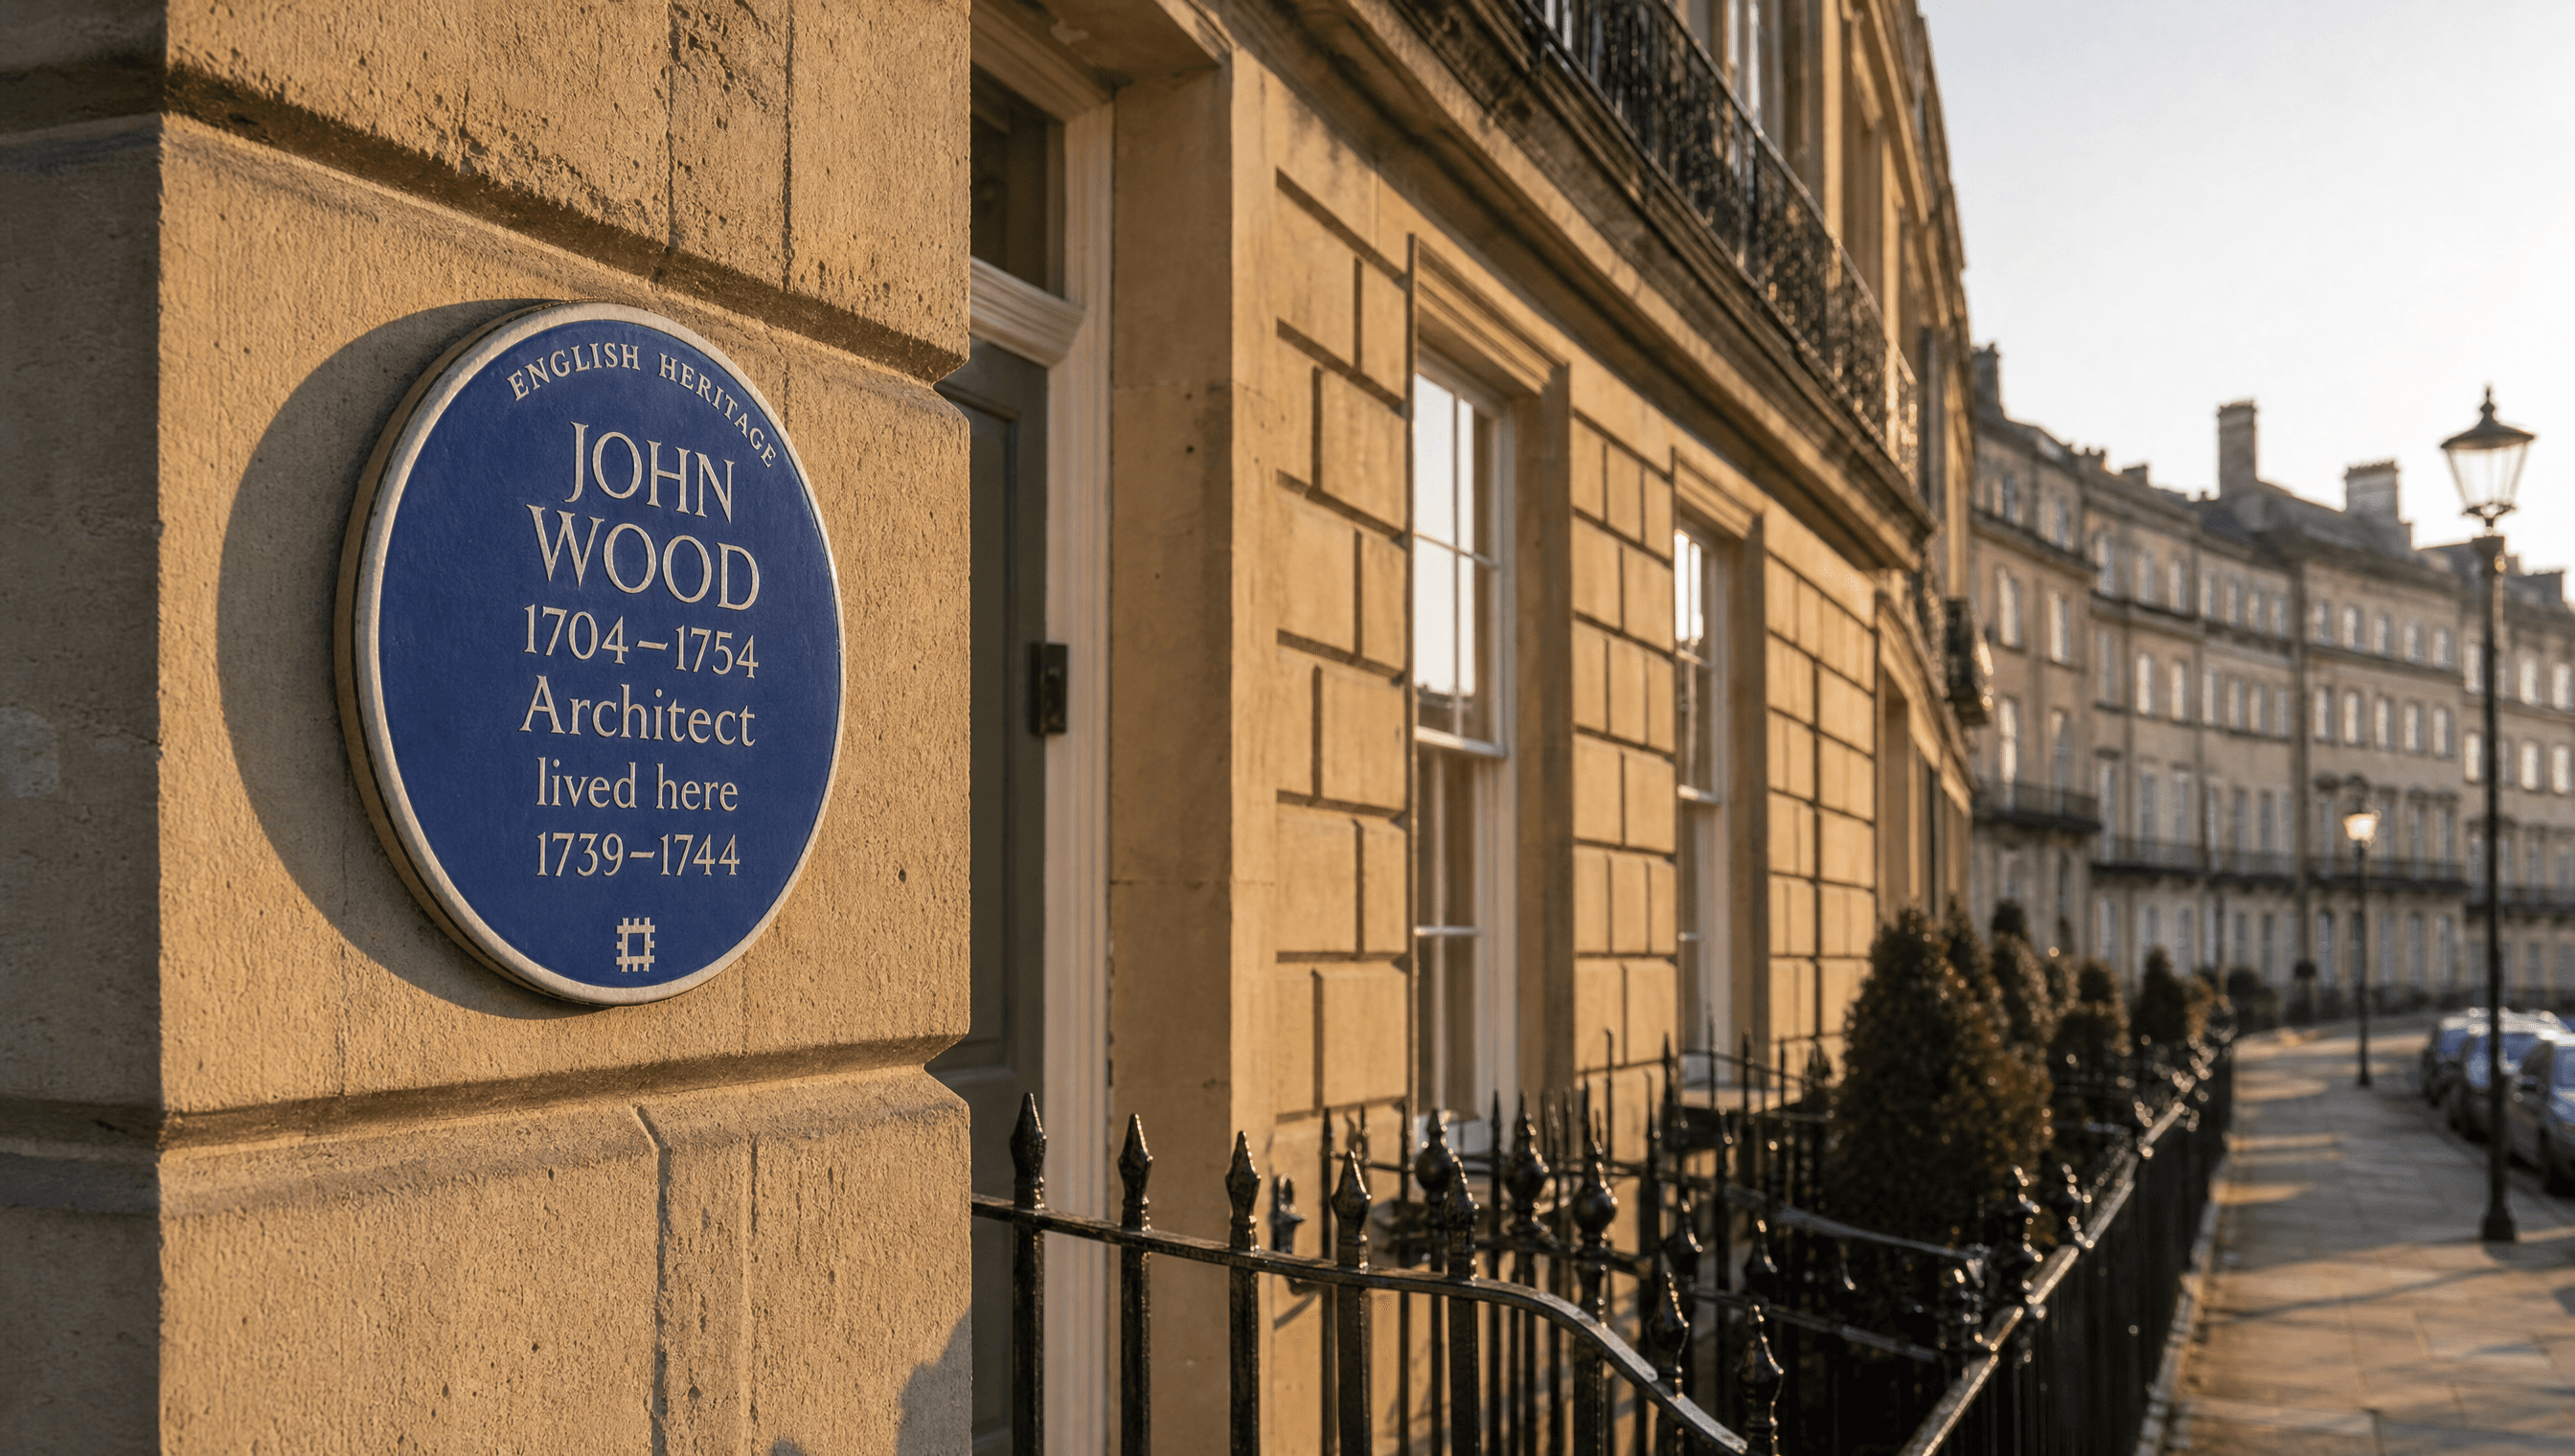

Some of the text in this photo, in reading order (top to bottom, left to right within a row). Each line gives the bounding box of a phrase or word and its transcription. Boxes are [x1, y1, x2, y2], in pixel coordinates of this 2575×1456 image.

[507, 342, 777, 468] ENGLISH HERITAGE
[564, 421, 736, 524] JOHN
[526, 503, 761, 611] WOOD
[523, 603, 760, 679] 1704–1754
[518, 674, 757, 747] Architect
[535, 756, 740, 811] lived here
[535, 830, 741, 877] 1739–1744
